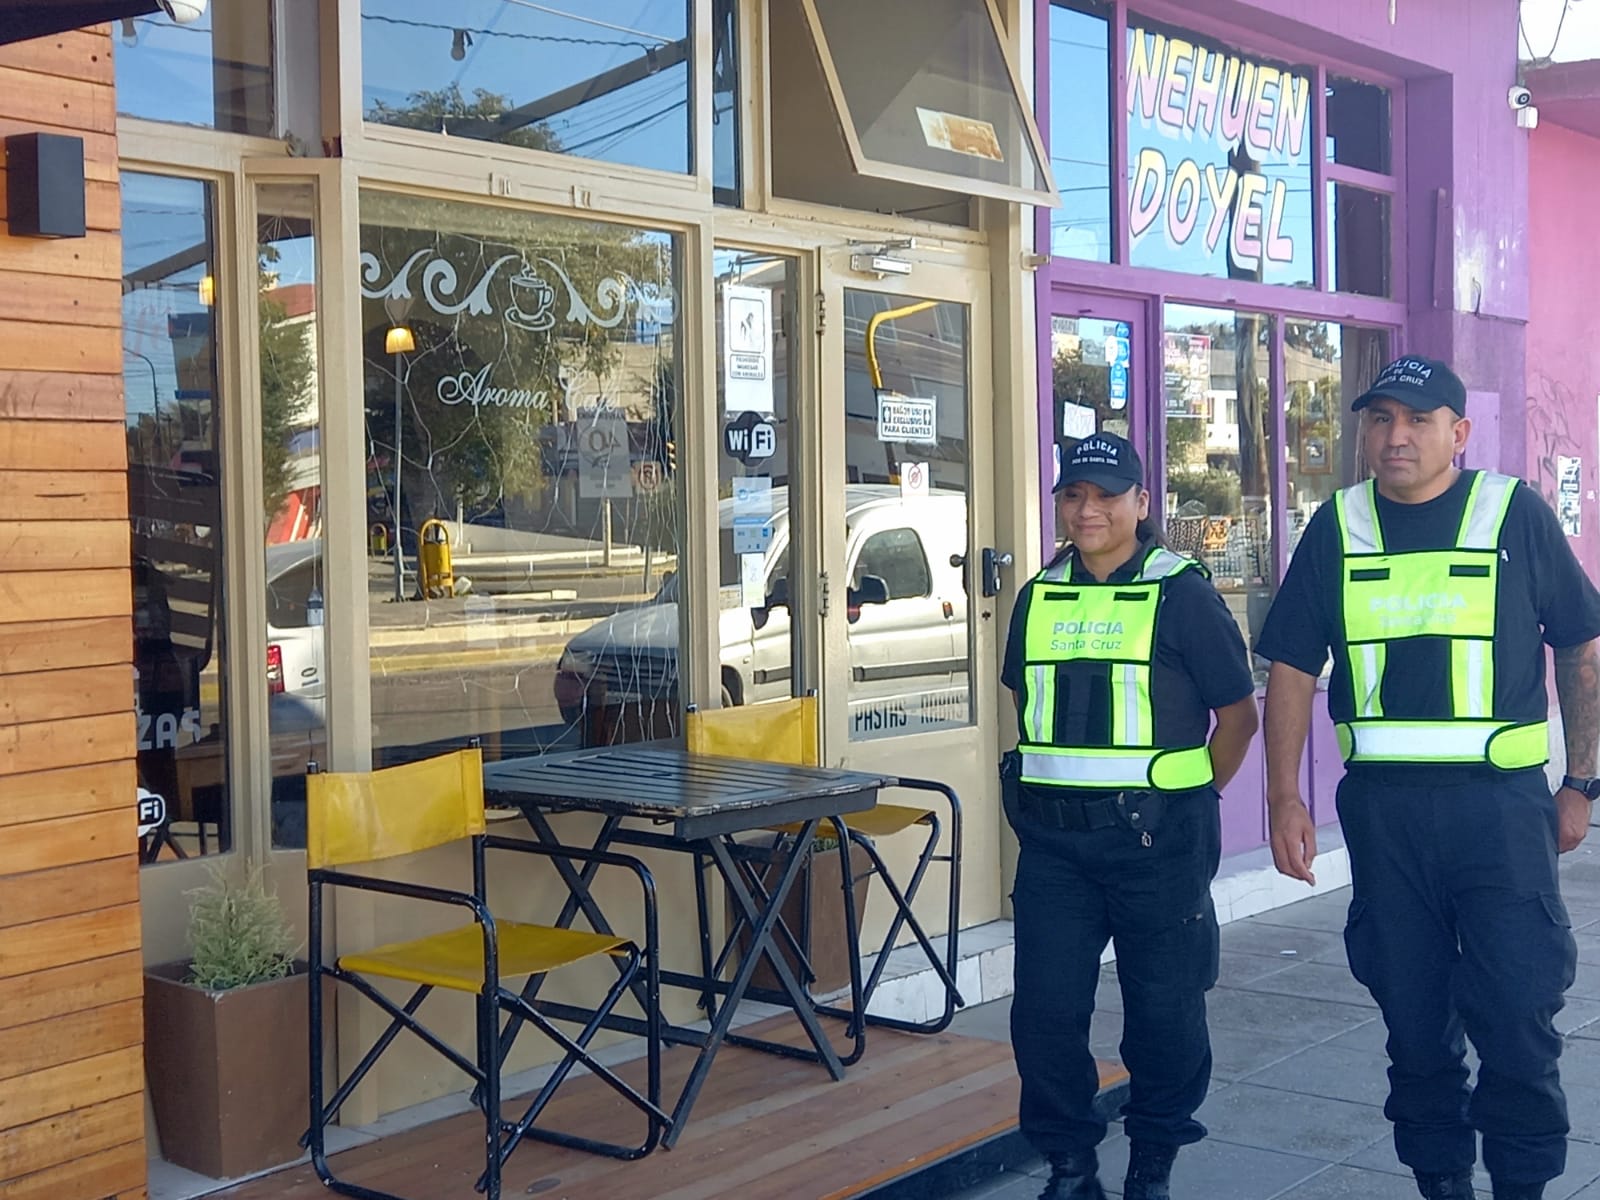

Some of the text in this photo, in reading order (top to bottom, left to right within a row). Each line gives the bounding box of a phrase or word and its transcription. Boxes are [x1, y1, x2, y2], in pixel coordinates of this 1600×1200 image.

[1127, 27, 1309, 157] NEHUEN
[1130, 147, 1294, 265] DOYEL
[436, 361, 549, 411] Aroma
[1399, 374, 1425, 387] CRUZ
[884, 424, 931, 436] PARA CLIENTES
[1076, 440, 1118, 457] POLICIA
[1369, 592, 1467, 613] POLICIA
[1053, 621, 1124, 635] POLICIA
[1050, 639, 1123, 651] Santa Cruz
[855, 698, 907, 732] PASTAS
